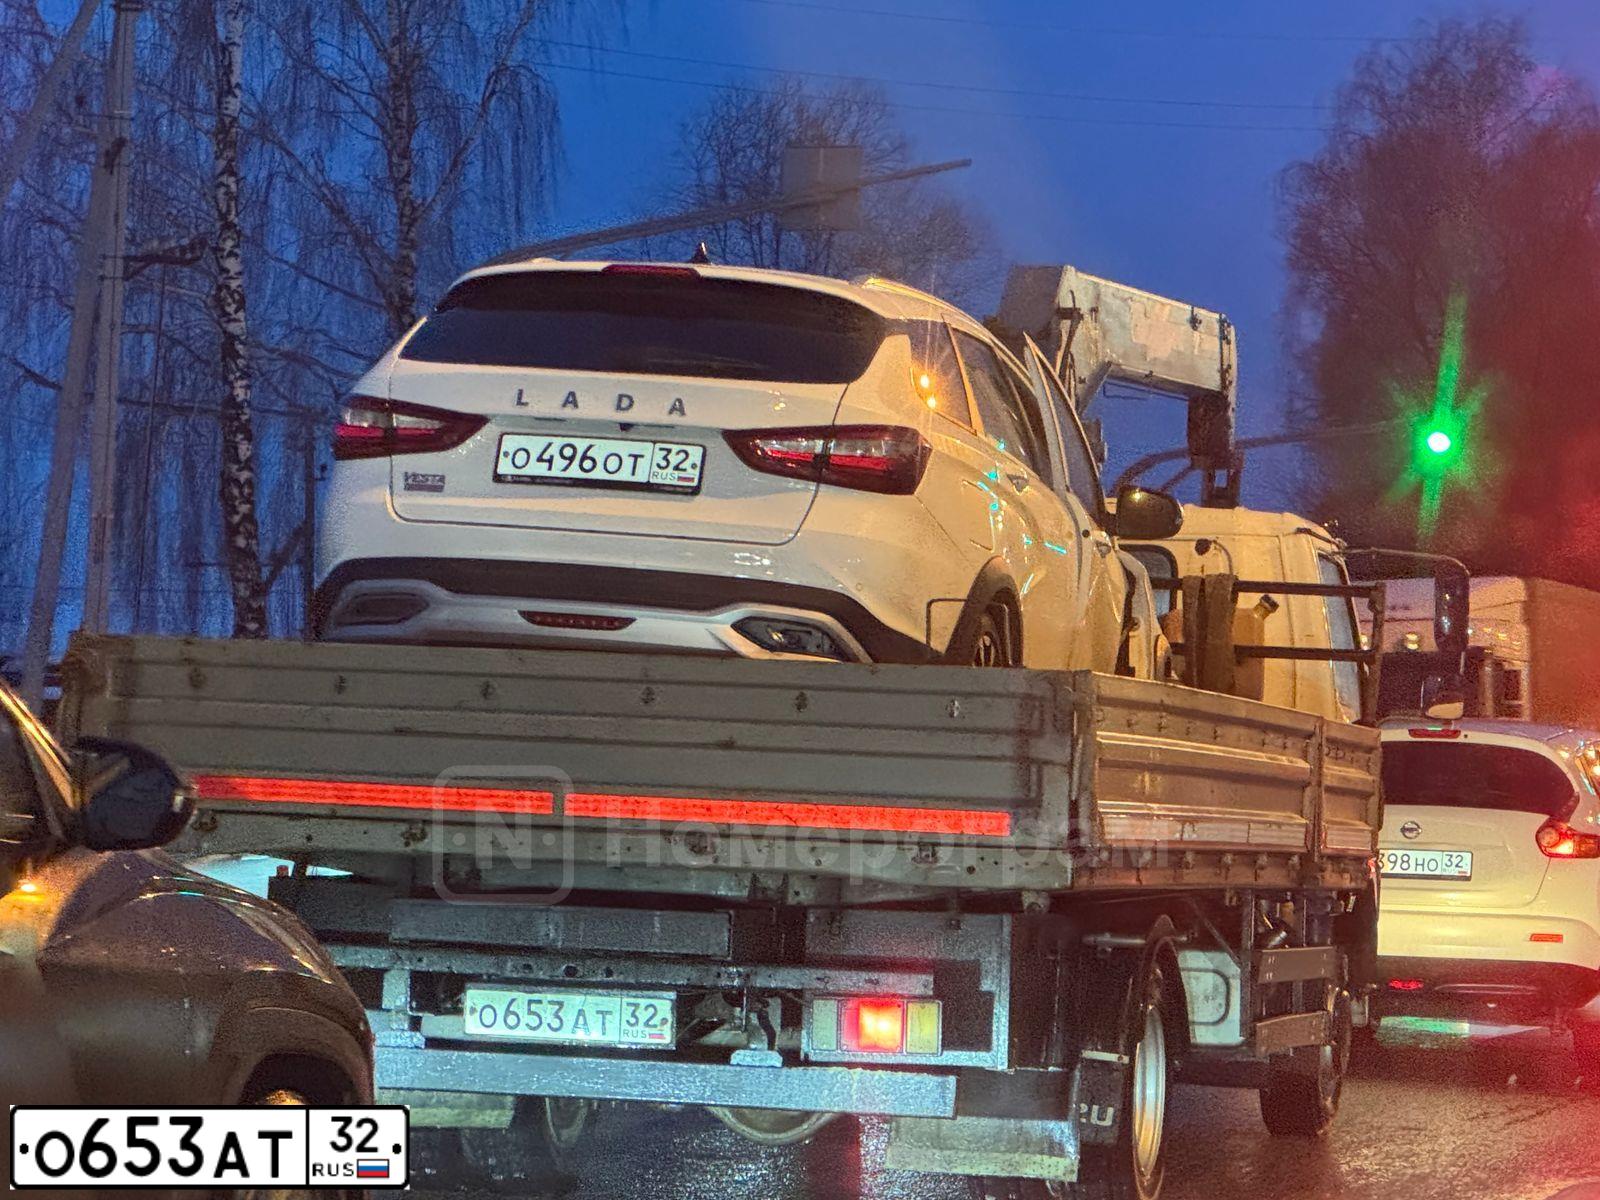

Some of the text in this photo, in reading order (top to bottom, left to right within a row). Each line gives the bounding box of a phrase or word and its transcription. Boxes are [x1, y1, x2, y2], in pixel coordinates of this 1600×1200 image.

[516, 388, 687, 417] LADA
[511, 442, 690, 477] О496ОТ 32
[652, 471, 676, 482] RUS
[1444, 853, 1464, 869] 32
[478, 998, 659, 1036] О653АТ 32
[622, 1028, 647, 1039] RUS
